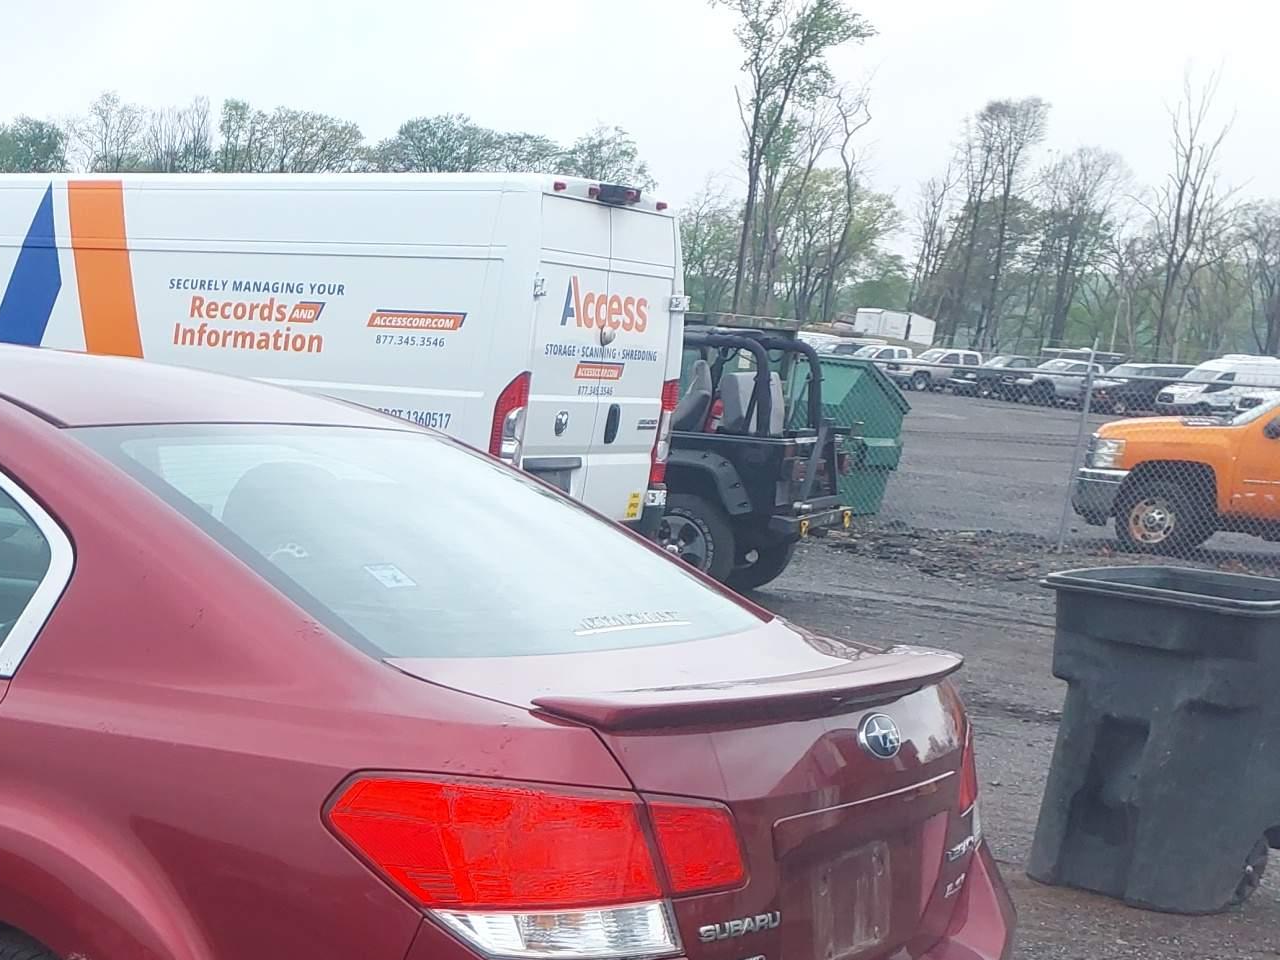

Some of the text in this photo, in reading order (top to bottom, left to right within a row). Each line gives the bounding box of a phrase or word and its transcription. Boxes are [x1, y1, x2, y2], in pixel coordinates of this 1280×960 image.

[169, 278, 346, 296] SECURELY MANAGING YOUR
[189, 295, 313, 322] Records AND
[560, 275, 648, 333] Access
[373, 315, 454, 329] ACCESSCORP.COM
[173, 322, 323, 352] Information
[375, 334, 446, 347] 877.345.3546
[545, 344, 658, 361] STORAGE SCANNING SHREDDING
[407, 410, 451, 429] 1360517
[699, 911, 781, 942] SUBARU
